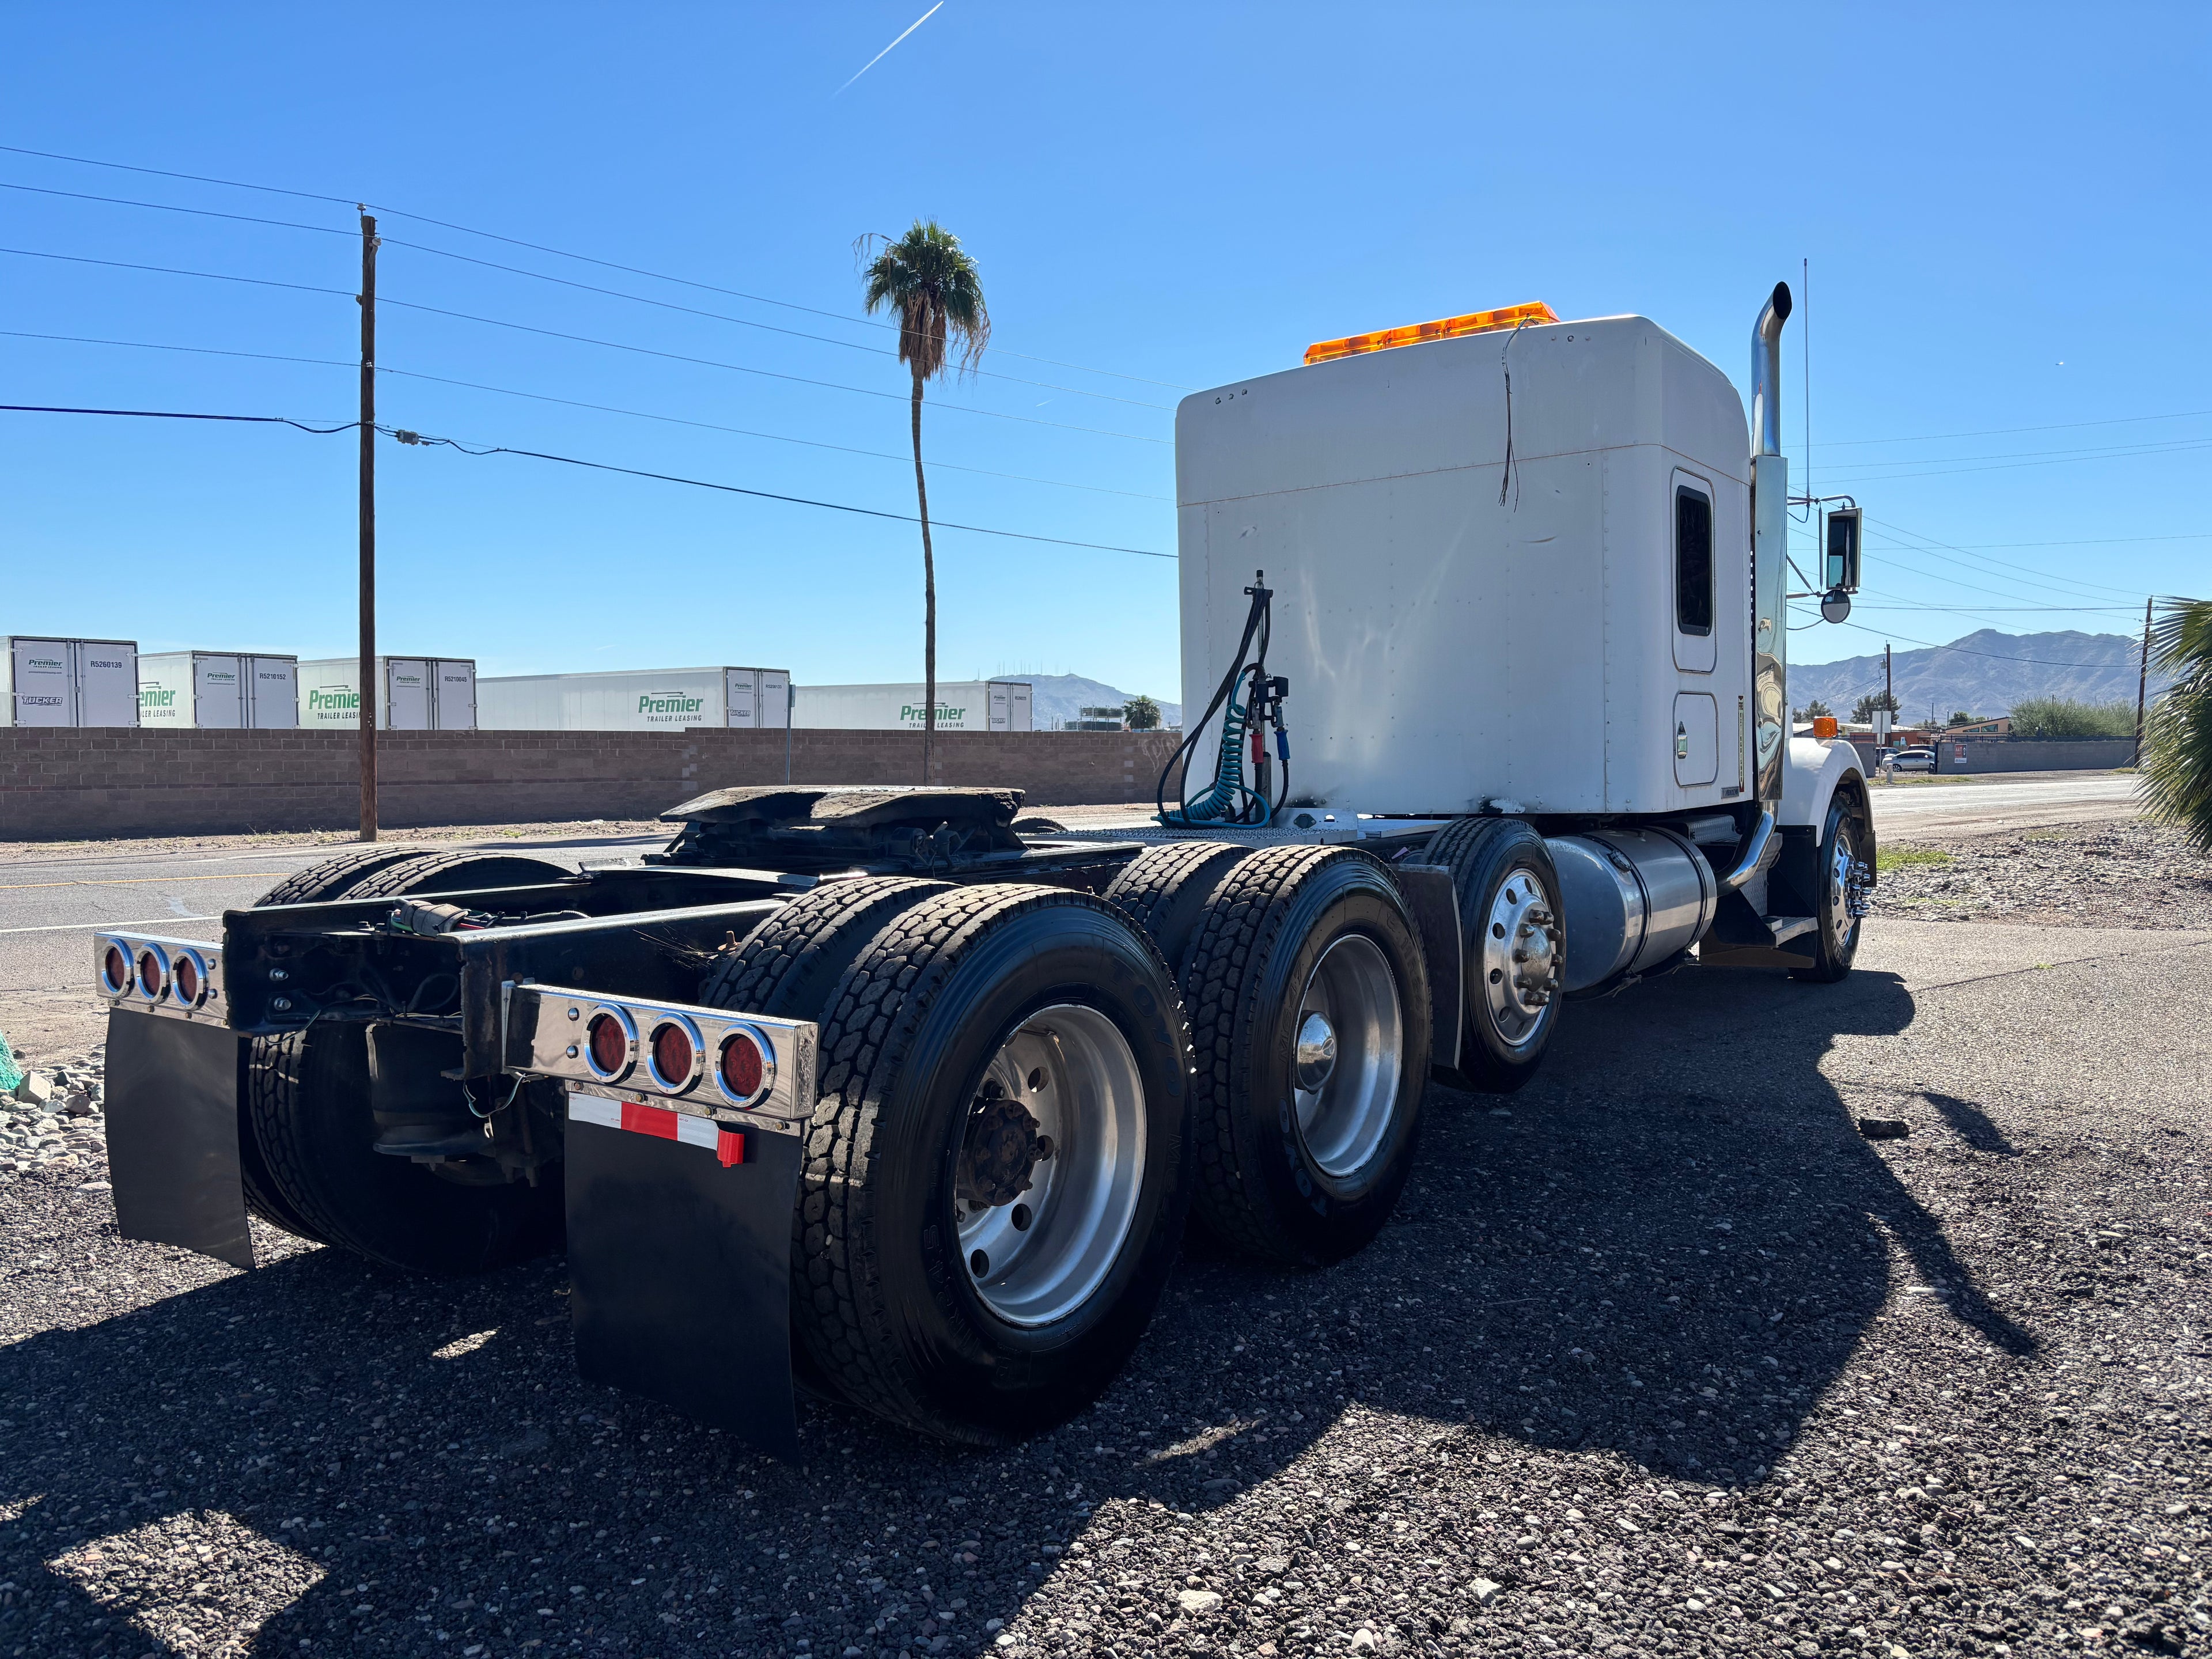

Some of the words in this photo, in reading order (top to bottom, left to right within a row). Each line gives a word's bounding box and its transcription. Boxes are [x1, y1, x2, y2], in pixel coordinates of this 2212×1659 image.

[22, 696, 63, 705] TUCKER
[139, 688, 176, 707] emier
[309, 690, 360, 709] Premie
[638, 695, 704, 713] Premier
[153, 709, 176, 717] LEASING
[1279, 960, 1304, 1063] M647
[1107, 956, 1181, 1098] TOYO
[1279, 1096, 1328, 1219] TOYO
